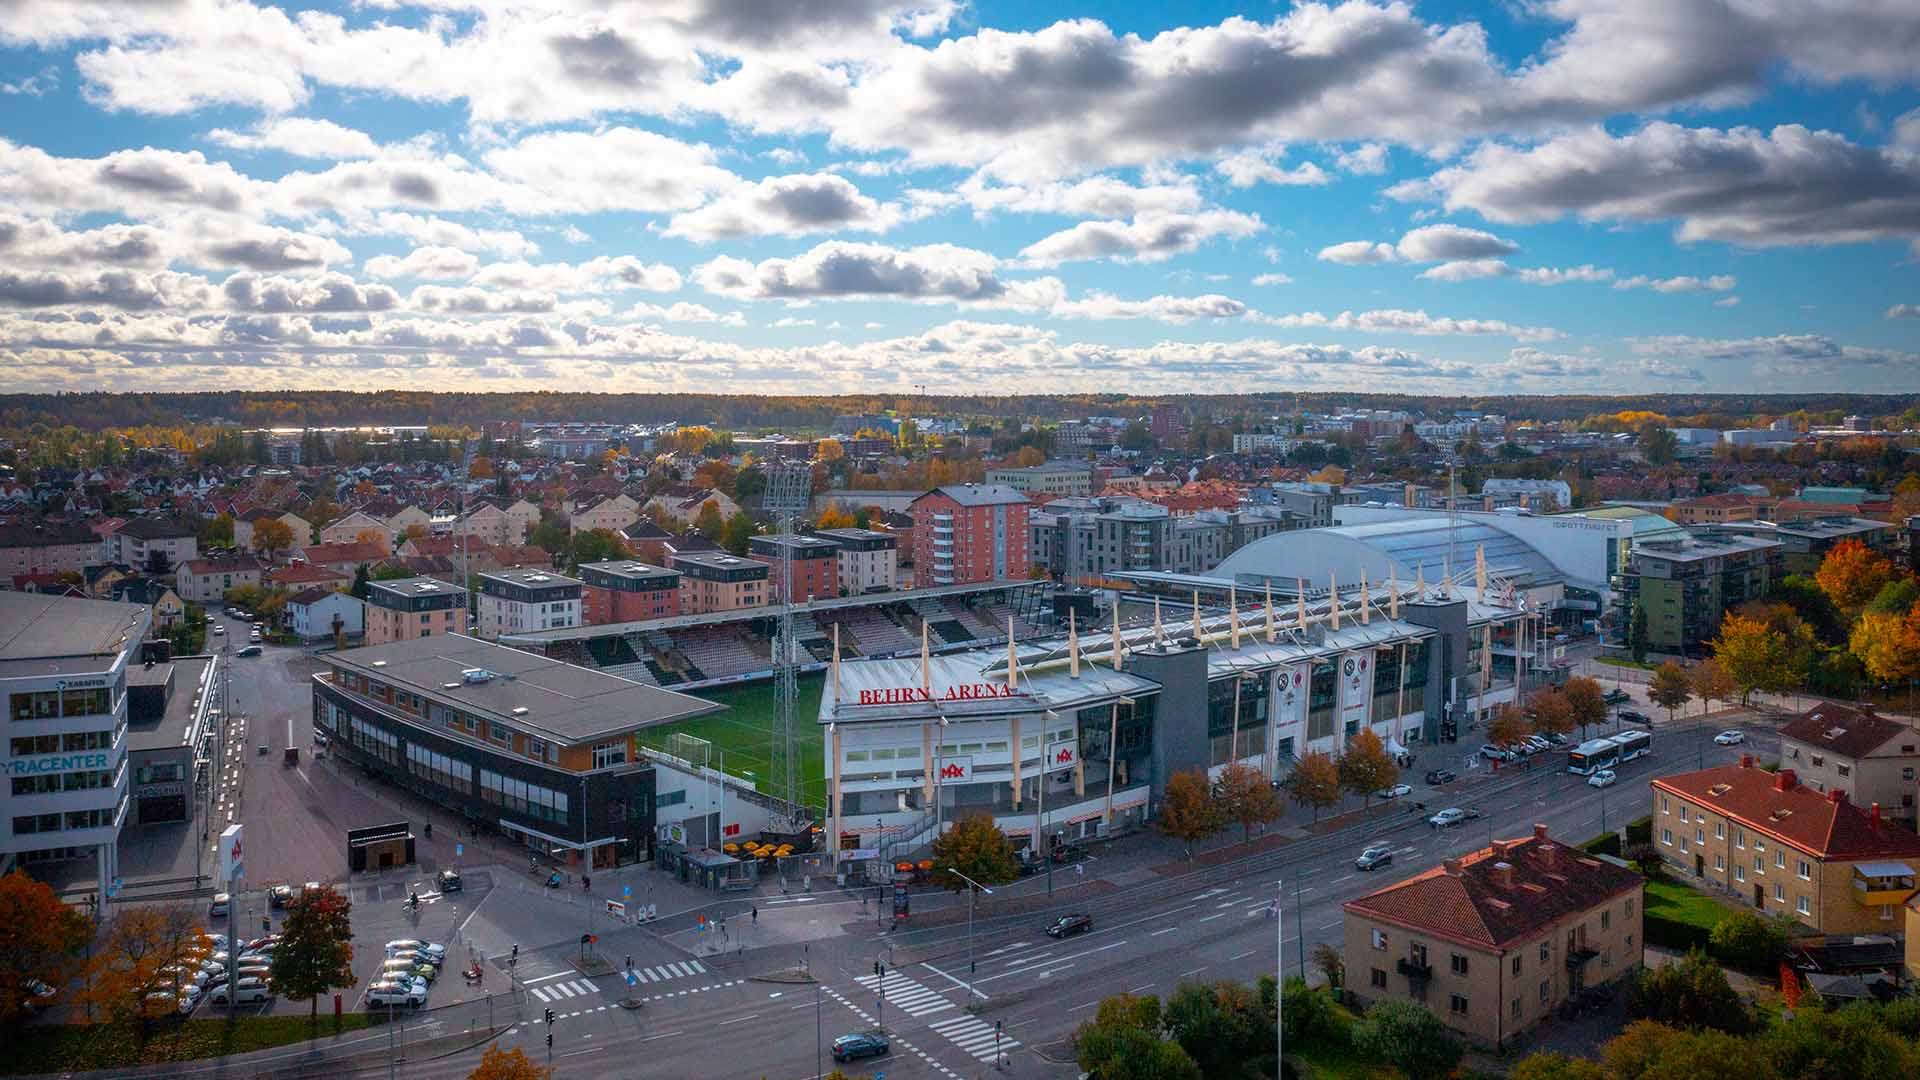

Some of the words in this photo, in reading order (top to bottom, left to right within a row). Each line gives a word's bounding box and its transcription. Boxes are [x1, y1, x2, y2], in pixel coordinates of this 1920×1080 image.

[860, 687, 929, 704] BEHRN
[944, 682, 1012, 700] ARENA
[940, 762, 965, 779] MAX
